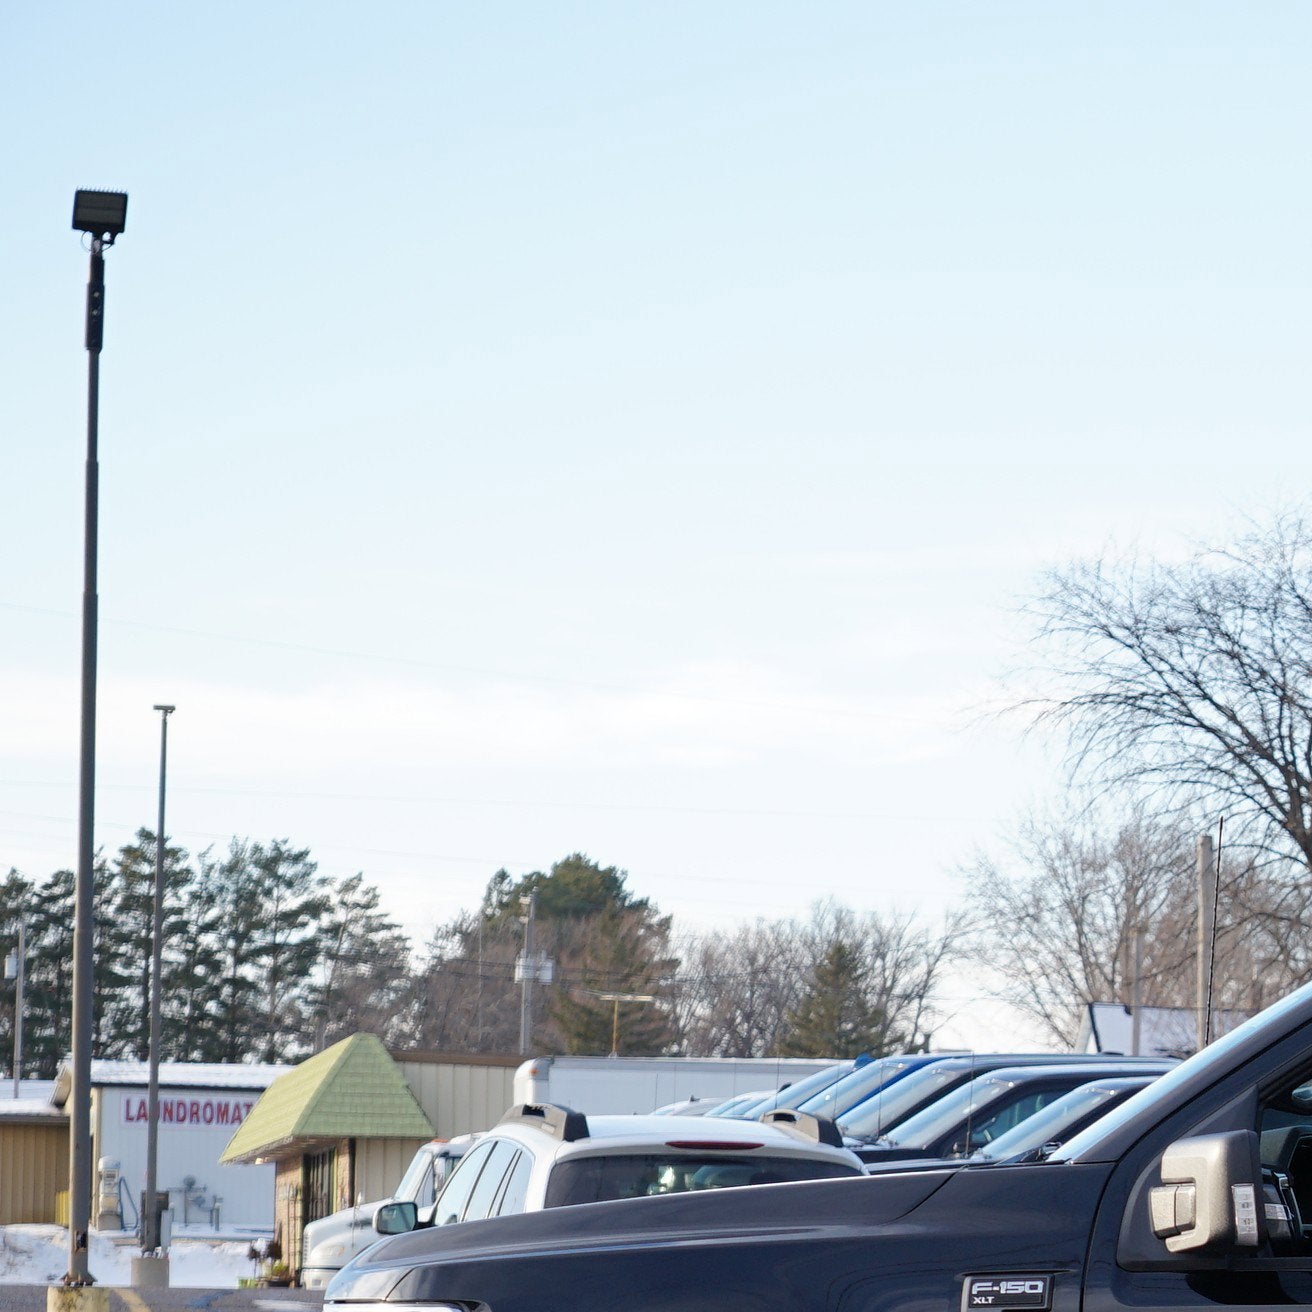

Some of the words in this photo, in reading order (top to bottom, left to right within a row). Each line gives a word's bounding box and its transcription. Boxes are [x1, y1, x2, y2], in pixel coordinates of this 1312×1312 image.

[125, 1098, 253, 1125] LANDROMAT
[971, 1280, 1044, 1295] F-150
[972, 1296, 995, 1305] XLT
